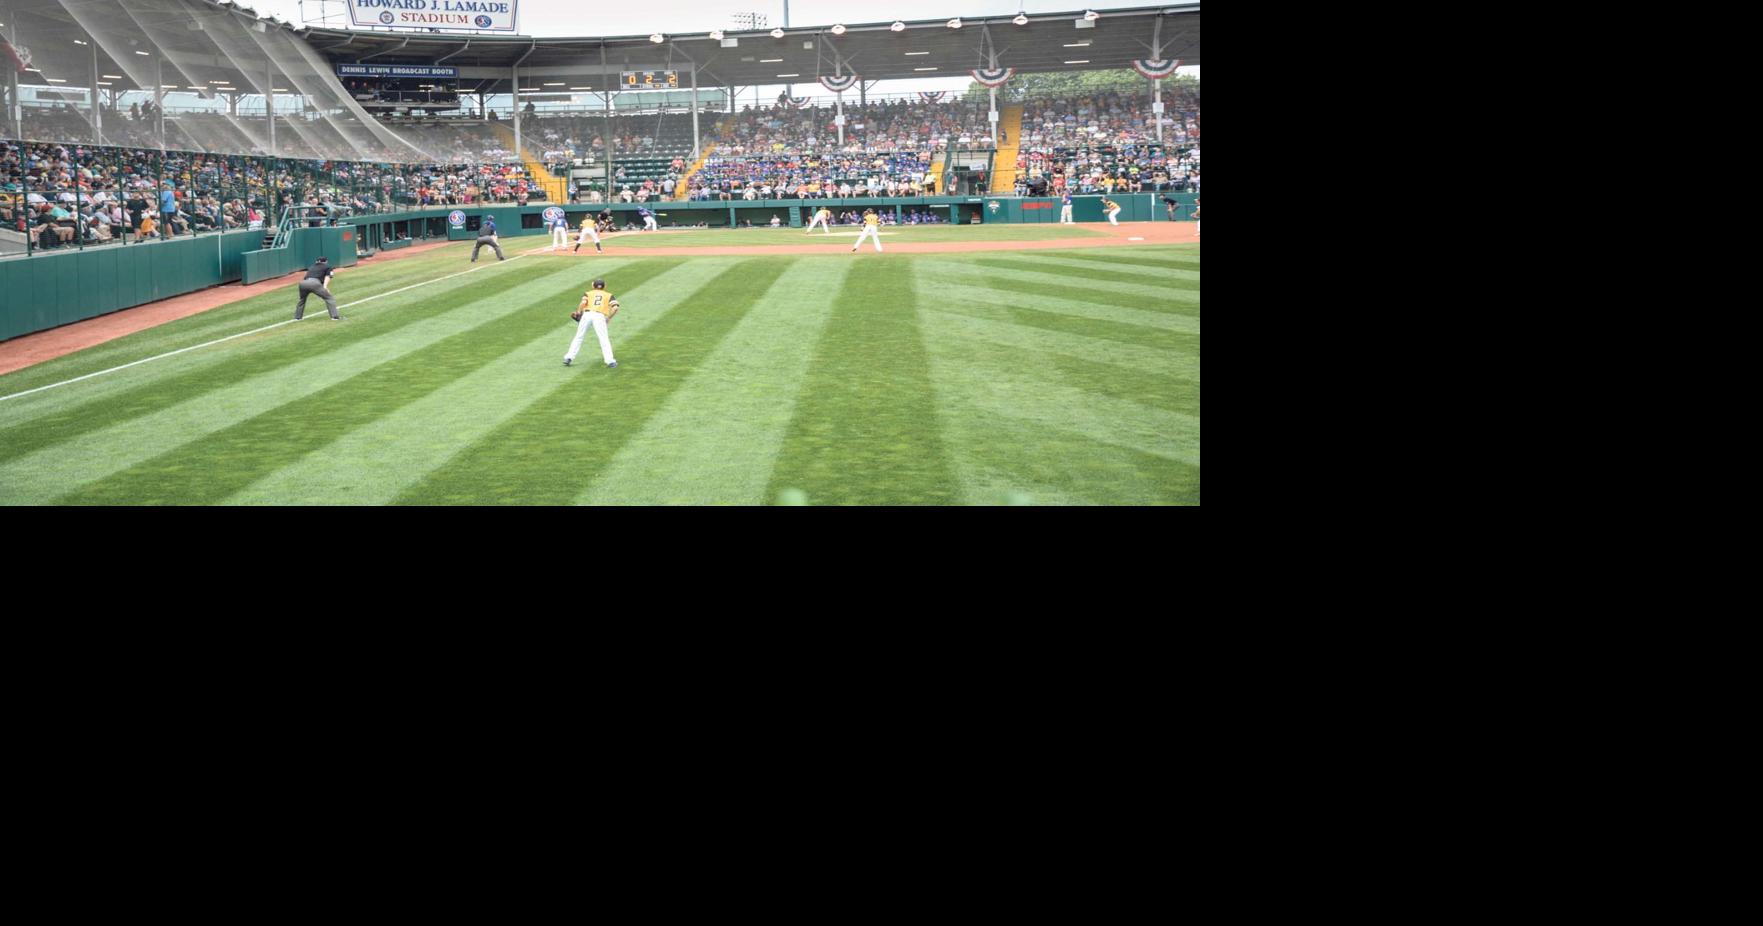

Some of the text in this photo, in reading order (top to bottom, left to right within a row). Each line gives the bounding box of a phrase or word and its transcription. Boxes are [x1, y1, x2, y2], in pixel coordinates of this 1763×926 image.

[357, 0, 509, 13] HOWARD J. LAMADE
[401, 12, 469, 24] STADIUM
[392, 67, 430, 75] BROADCAST
[629, 74, 676, 85] 0 2 2
[594, 295, 603, 306] 2
